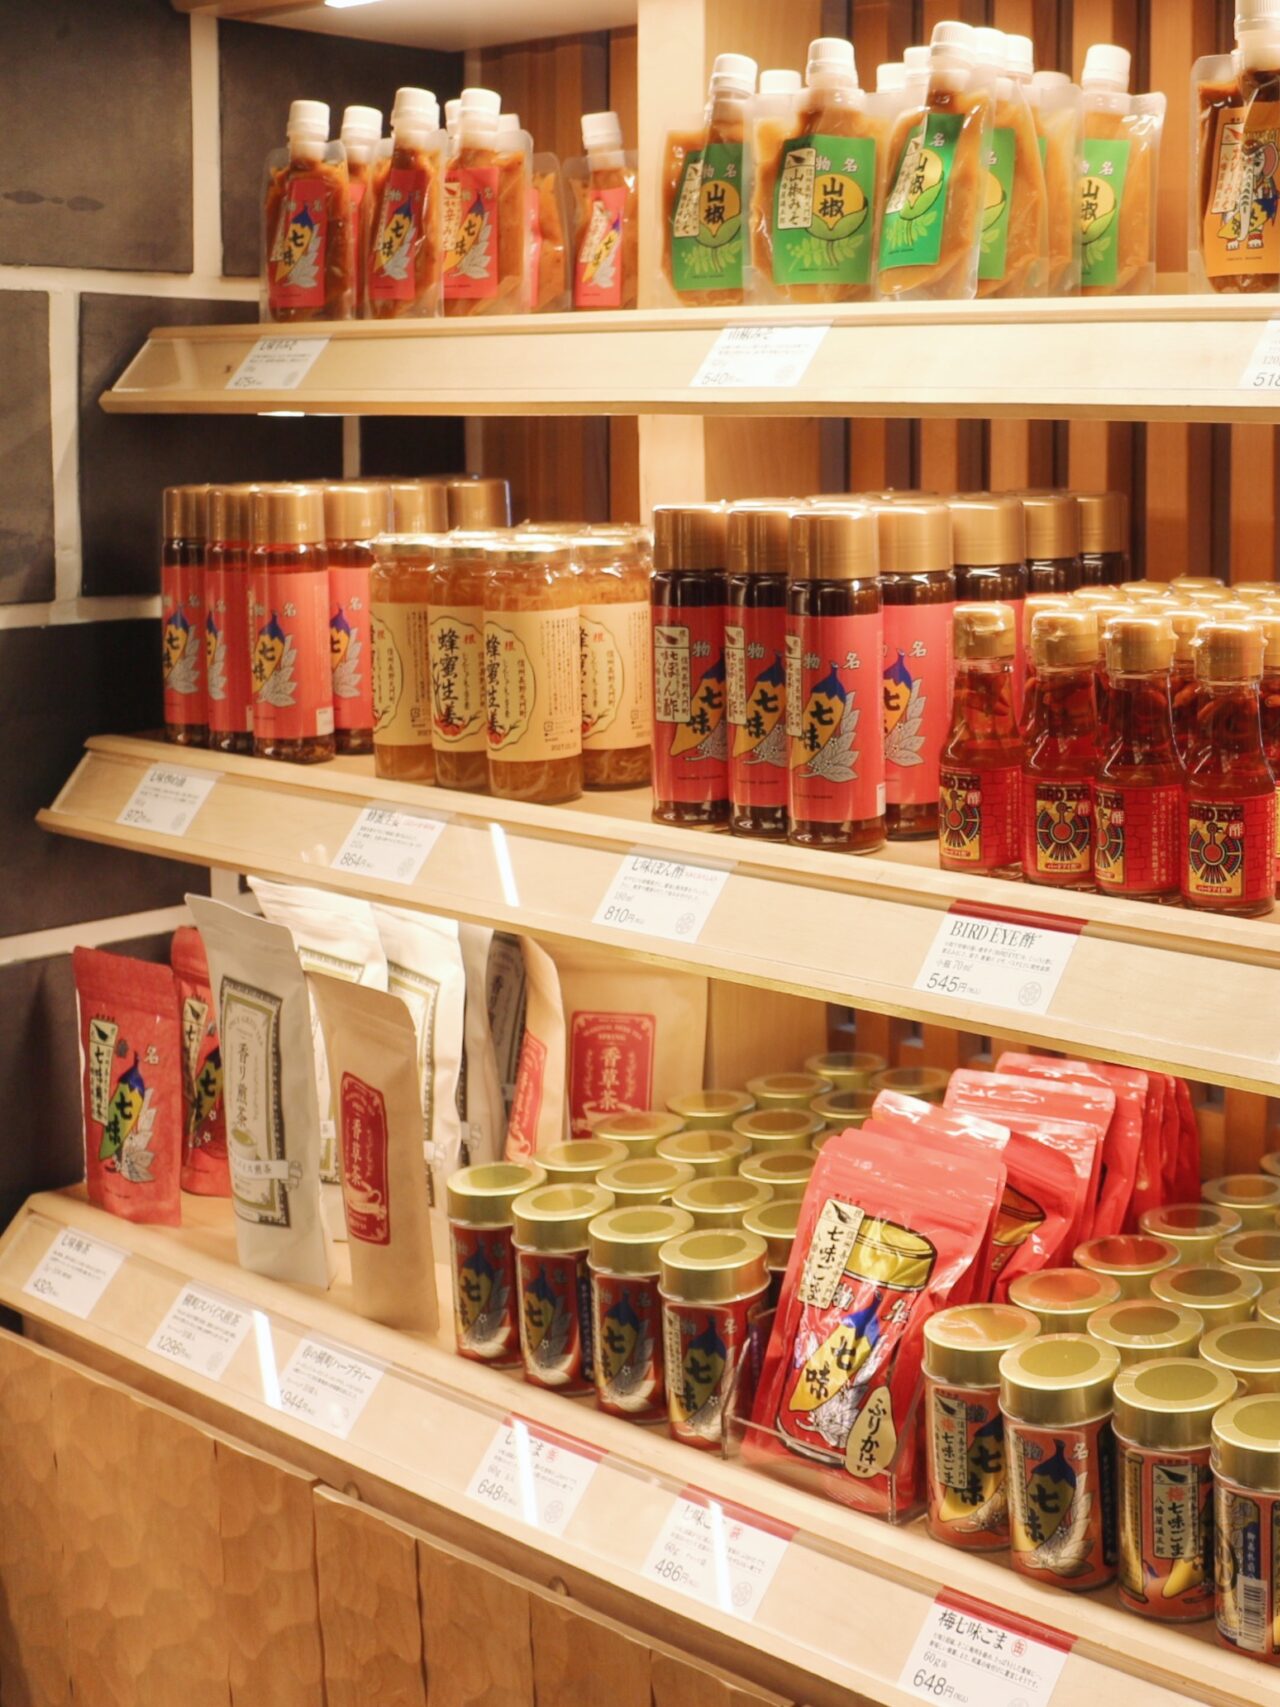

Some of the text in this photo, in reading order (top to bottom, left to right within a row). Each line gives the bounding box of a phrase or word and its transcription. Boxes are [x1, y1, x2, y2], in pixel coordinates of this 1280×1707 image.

[843, 158, 858, 172] 名
[1099, 160, 1114, 175] 名
[705, 183, 726, 225] 山椒
[819, 177, 845, 218] 山椒
[843, 652, 861, 670] 名
[909, 641, 928, 658] 名
[688, 686, 723, 735] 七味
[745, 690, 779, 739] 七味
[800, 701, 835, 752] 七味
[950, 920, 990, 941] BIRD
[927, 972, 968, 993] 545円
[144, 1045, 160, 1065] 名
[105, 1092, 133, 1147] 七味
[806, 1335, 857, 1401] 七味
[860, 1398, 888, 1467] ふりかけ
[1073, 1442, 1089, 1460] 名
[938, 1609, 1009, 1651] 梅七味ごま
[913, 1668, 955, 1699] 648円
